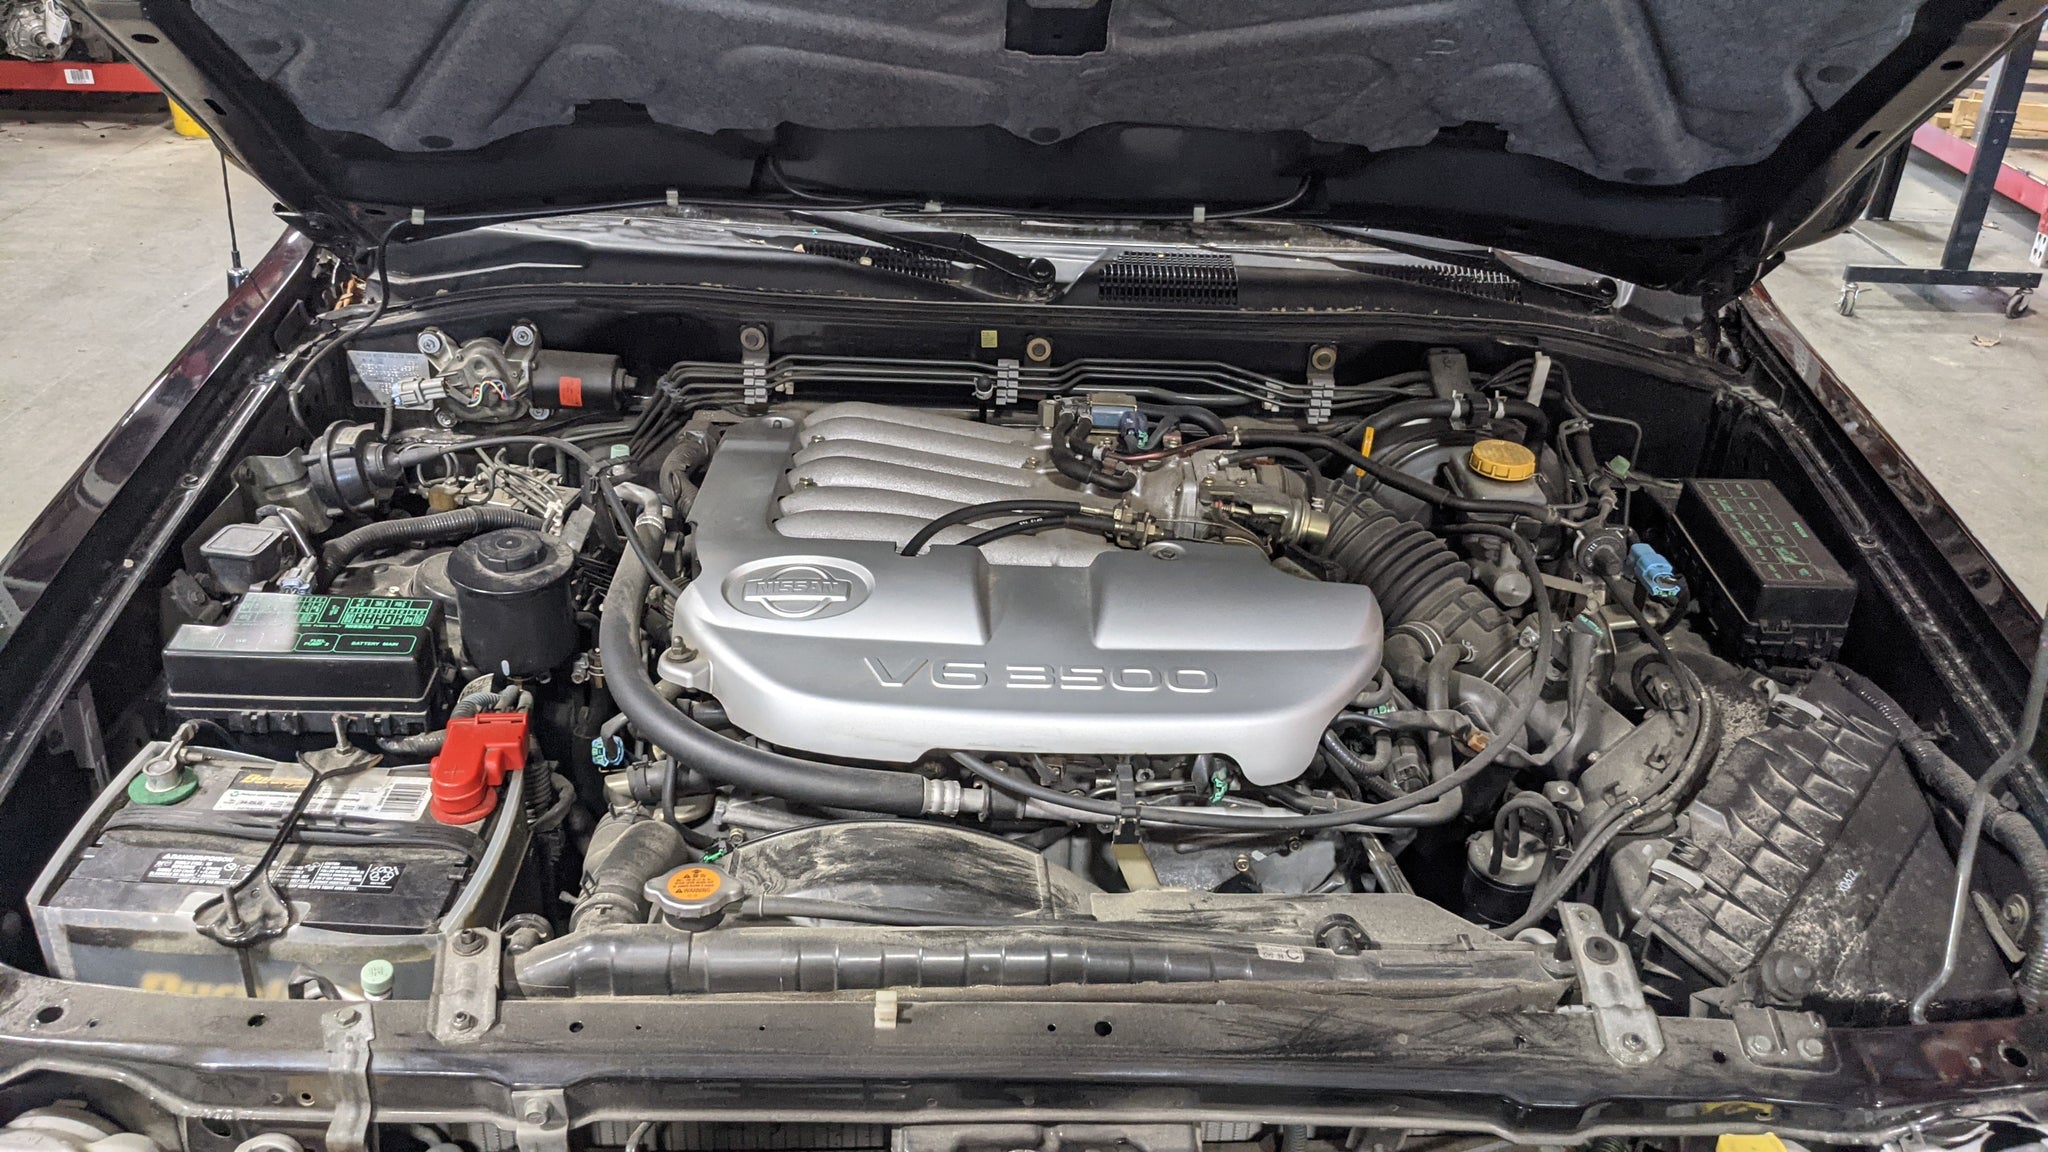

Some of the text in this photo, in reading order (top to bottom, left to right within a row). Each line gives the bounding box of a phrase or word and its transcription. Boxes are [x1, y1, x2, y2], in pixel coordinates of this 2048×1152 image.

[756, 581, 838, 594] NISSAN
[864, 657, 1218, 694] V6 3500
